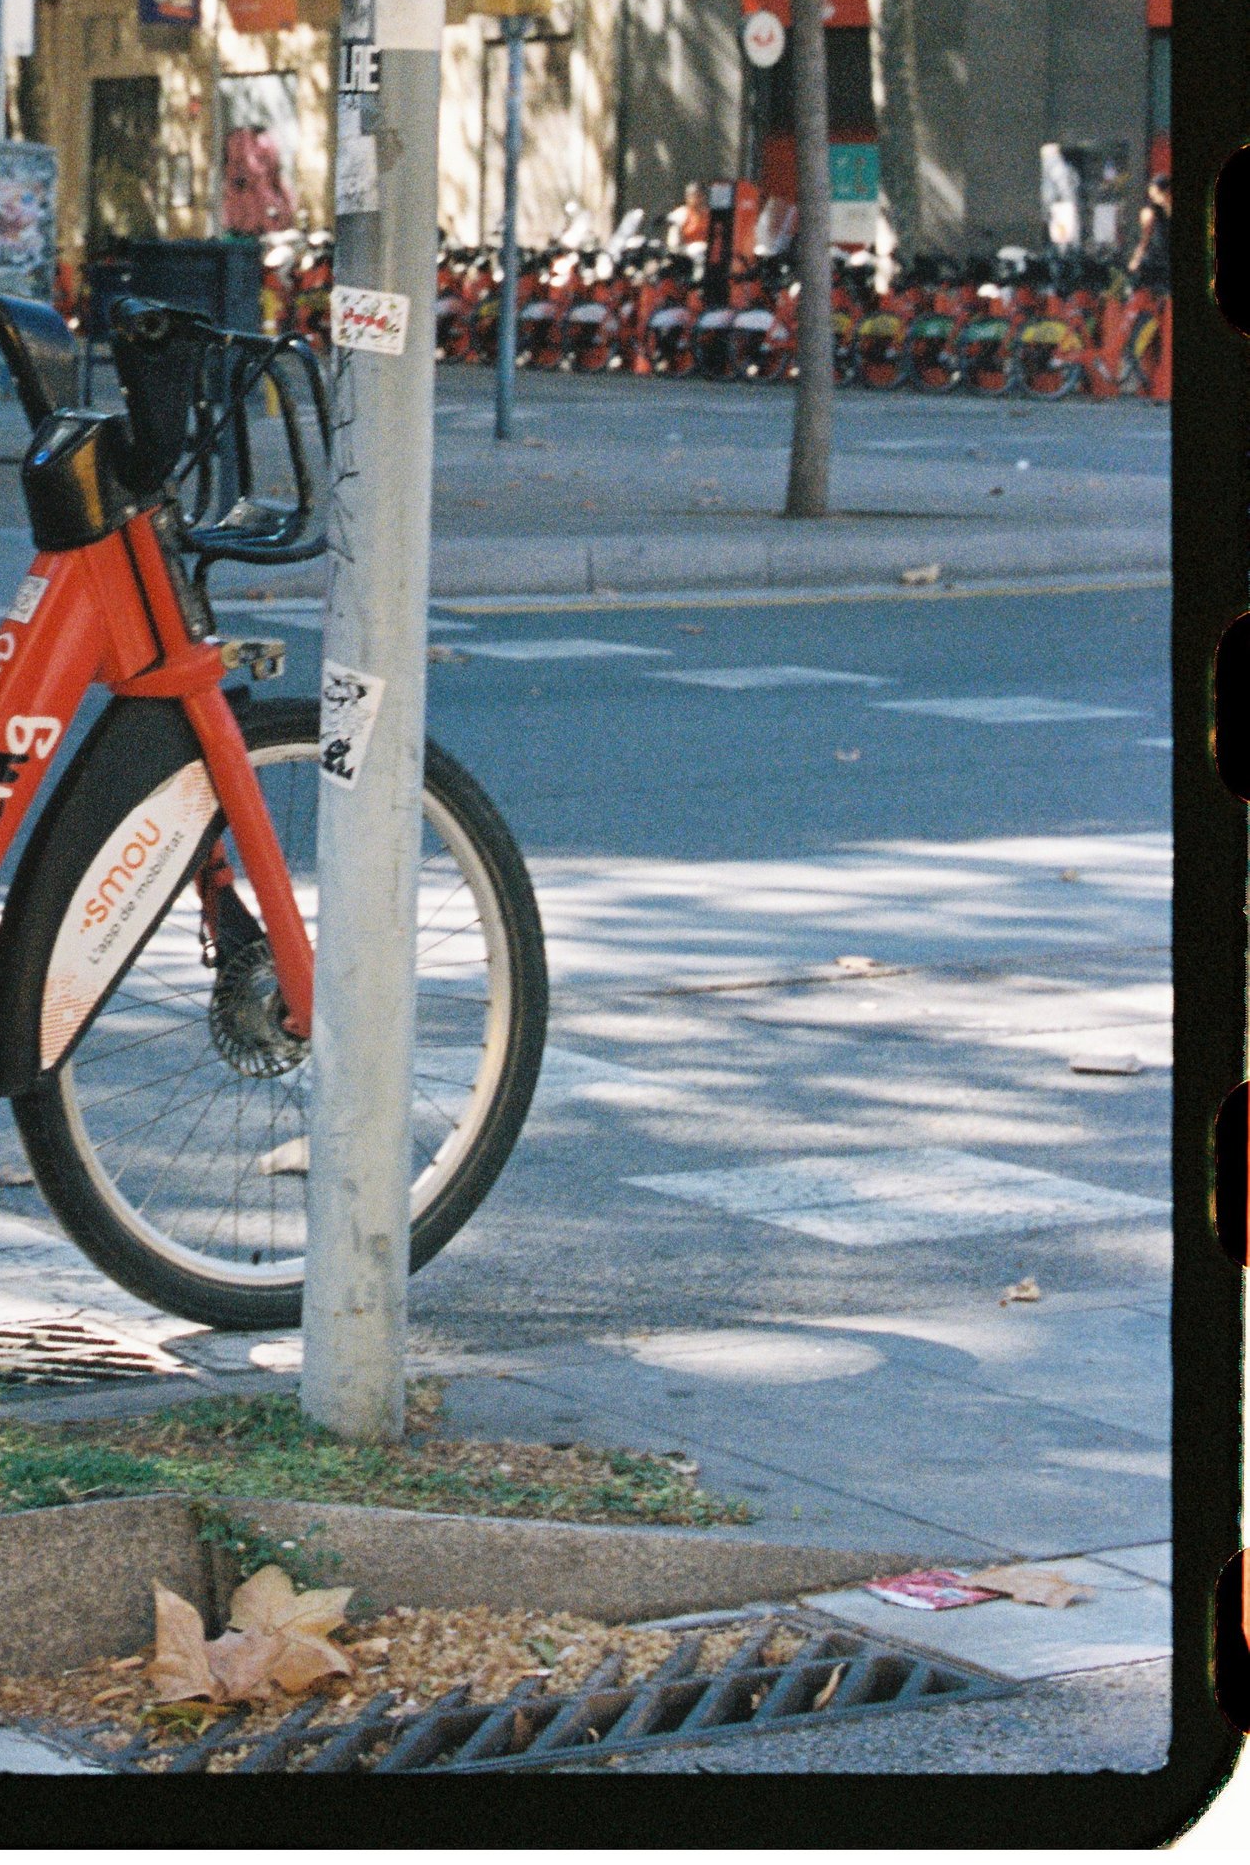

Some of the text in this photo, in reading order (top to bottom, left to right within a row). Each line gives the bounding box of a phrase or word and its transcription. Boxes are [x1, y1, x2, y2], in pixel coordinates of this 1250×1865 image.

[83, 817, 162, 924] smou
[87, 922, 121, 965] L'app
[120, 900, 136, 922] de
